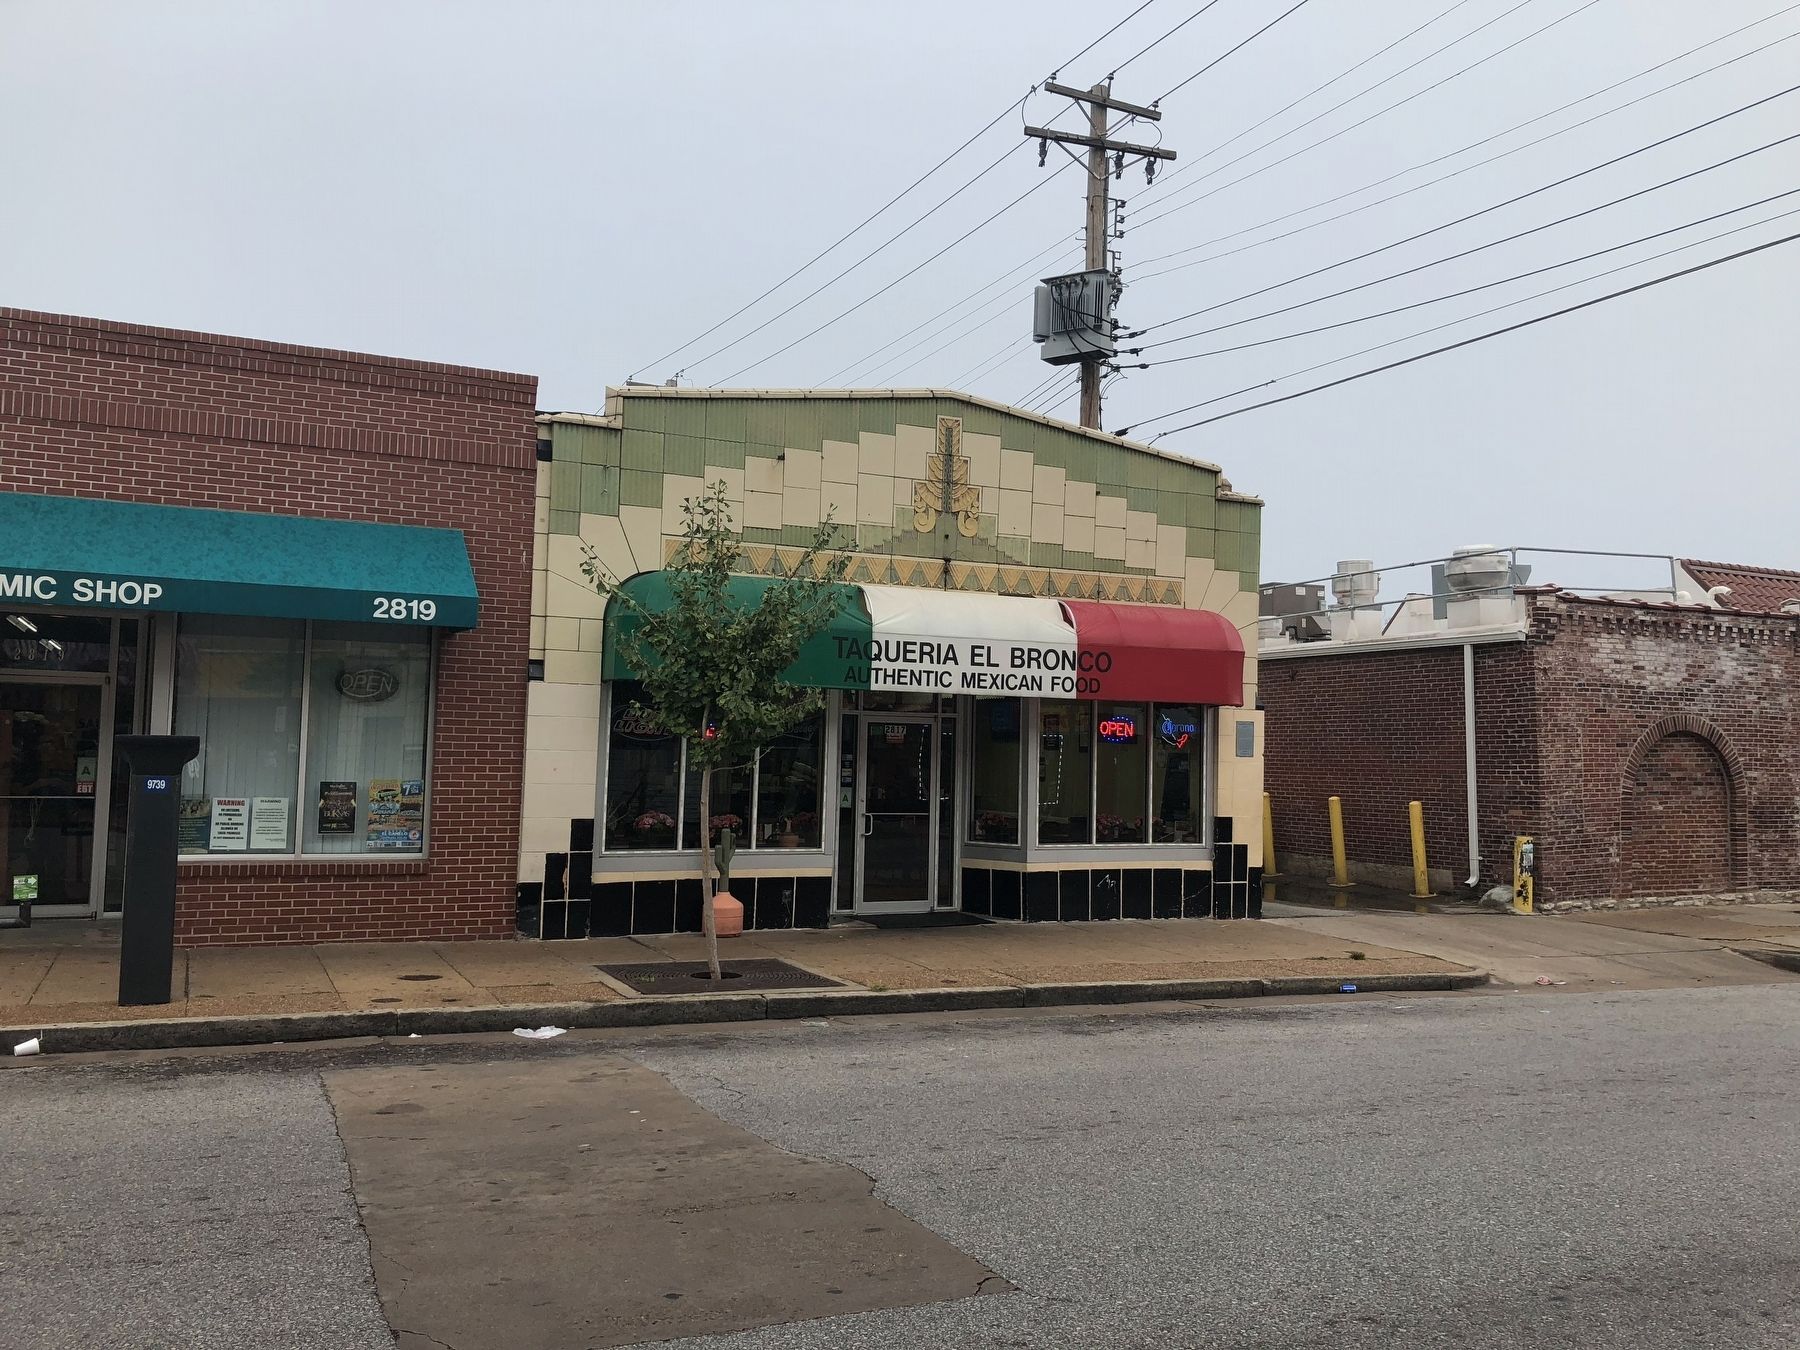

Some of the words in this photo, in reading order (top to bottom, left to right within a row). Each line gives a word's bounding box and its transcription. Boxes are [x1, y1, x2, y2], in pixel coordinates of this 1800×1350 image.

[72, 578, 163, 605] SHOP
[373, 597, 437, 621] 2819
[14, 648, 65, 662] 2819
[831, 636, 959, 667] TAQUERIA
[970, 645, 999, 668] EL
[1010, 647, 1112, 673] BRONCO
[340, 673, 393, 693] OPEN
[844, 665, 953, 689] AUTHENTIC
[961, 672, 1042, 692] MEXICAN
[1050, 676, 1100, 694] FOOD
[885, 725, 906, 734] 2817
[1100, 721, 1135, 737] OPEN
[82, 766, 91, 775] A
[77, 785, 94, 793] EBT
[147, 780, 166, 789] 9739
[841, 794, 849, 802] A
